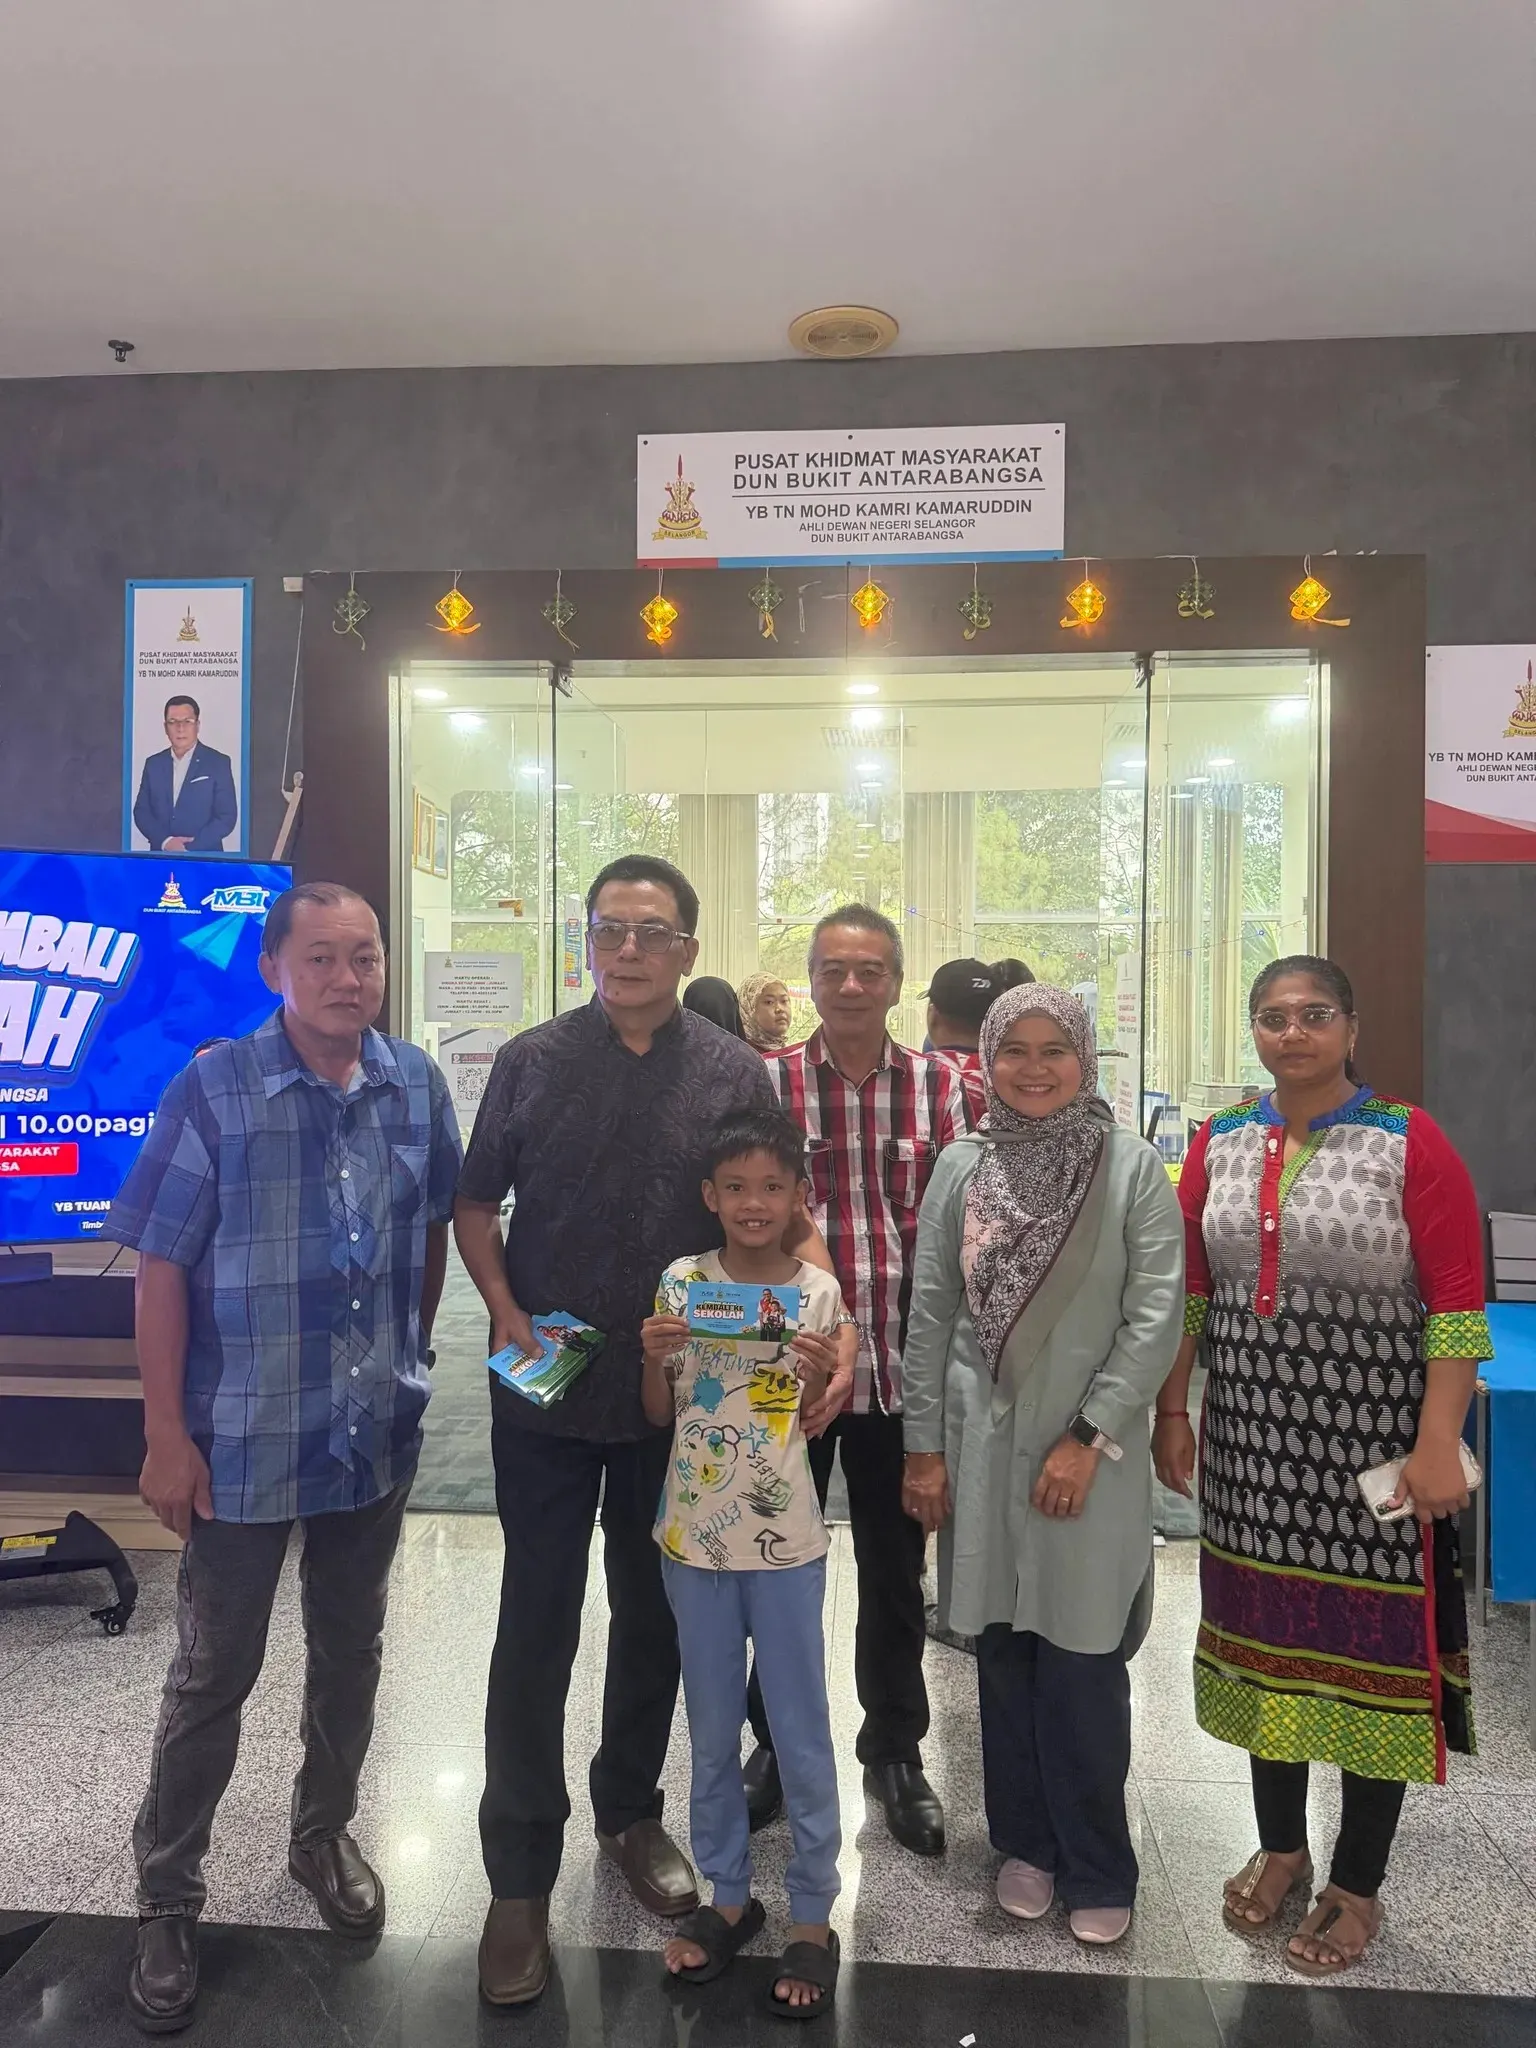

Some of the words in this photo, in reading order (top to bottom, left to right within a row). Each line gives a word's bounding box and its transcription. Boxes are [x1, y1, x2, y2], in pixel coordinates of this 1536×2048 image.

[735, 453, 799, 469] PUSAT
[806, 451, 895, 468] KHIDMAT
[902, 447, 1042, 465] MASYARAKAT
[734, 473, 777, 489] DUN
[787, 472, 851, 488] BUKIT
[859, 467, 1043, 487] ANTARABANGSA
[746, 505, 768, 519] YB
[773, 505, 795, 518] TN
[801, 503, 850, 518] MOHD
[856, 502, 910, 517] KAMRI
[916, 499, 1032, 515] KAMARUDDIN
[799, 522, 824, 531] AHLI
[827, 521, 867, 531] DEWAN
[870, 520, 911, 530] NEGERI
[914, 519, 976, 529] SELANGOR
[811, 533, 834, 543] DUN
[837, 532, 870, 542] BUKIT
[872, 530, 964, 542] ANTARABANGSA
[138, 670, 147, 678] YB
[148, 670, 157, 678] TN
[158, 670, 176, 678] MOHD
[1428, 752, 1444, 762] YB
[1448, 752, 1463, 762] TN
[1467, 752, 1503, 761] MOHD
[1457, 764, 1477, 772] AHLI
[1480, 764, 1512, 772] DEWAN
[1466, 774, 1485, 782] DUN
[1488, 774, 1515, 782] BUKIT
[212, 889, 265, 908] MBI
[16, 1111, 155, 1137] 10.00pagi
[0, 1161, 21, 1172] SA
[54, 1202, 73, 1212] YB
[75, 1200, 111, 1211] TUAN
[81, 1220, 105, 1230] Timb
[693, 1309, 745, 1320] SEKOLAH
